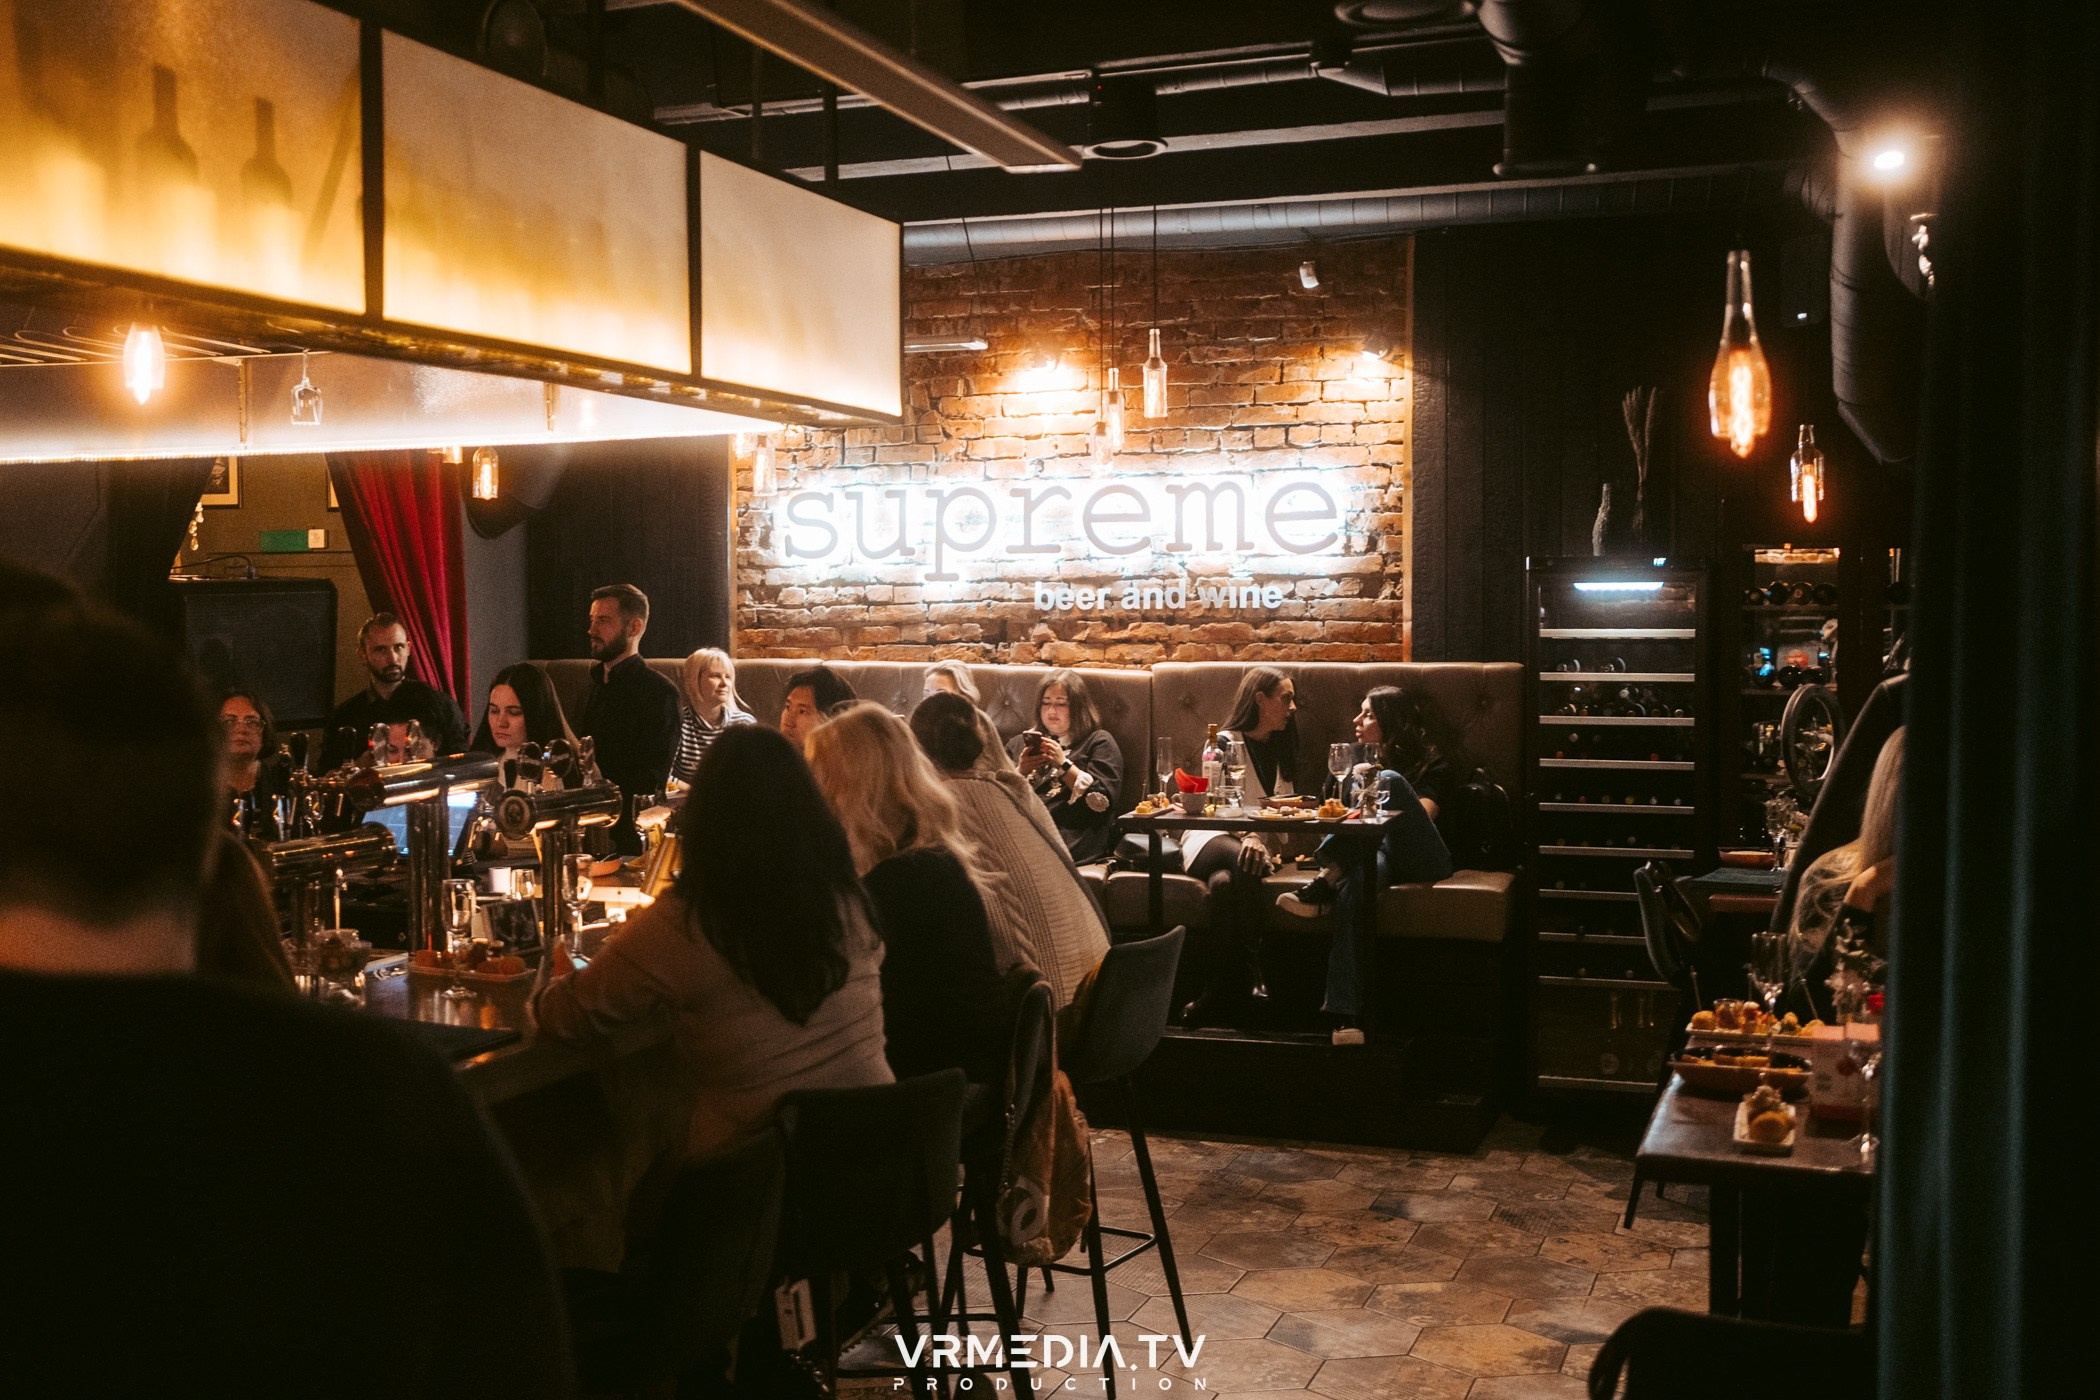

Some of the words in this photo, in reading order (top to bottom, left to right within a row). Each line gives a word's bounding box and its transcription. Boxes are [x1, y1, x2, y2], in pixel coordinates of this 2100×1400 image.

[785, 480, 1338, 582] supreme
[1033, 580, 1112, 611] beer
[1120, 577, 1187, 610] and
[1197, 582, 1283, 610] wine
